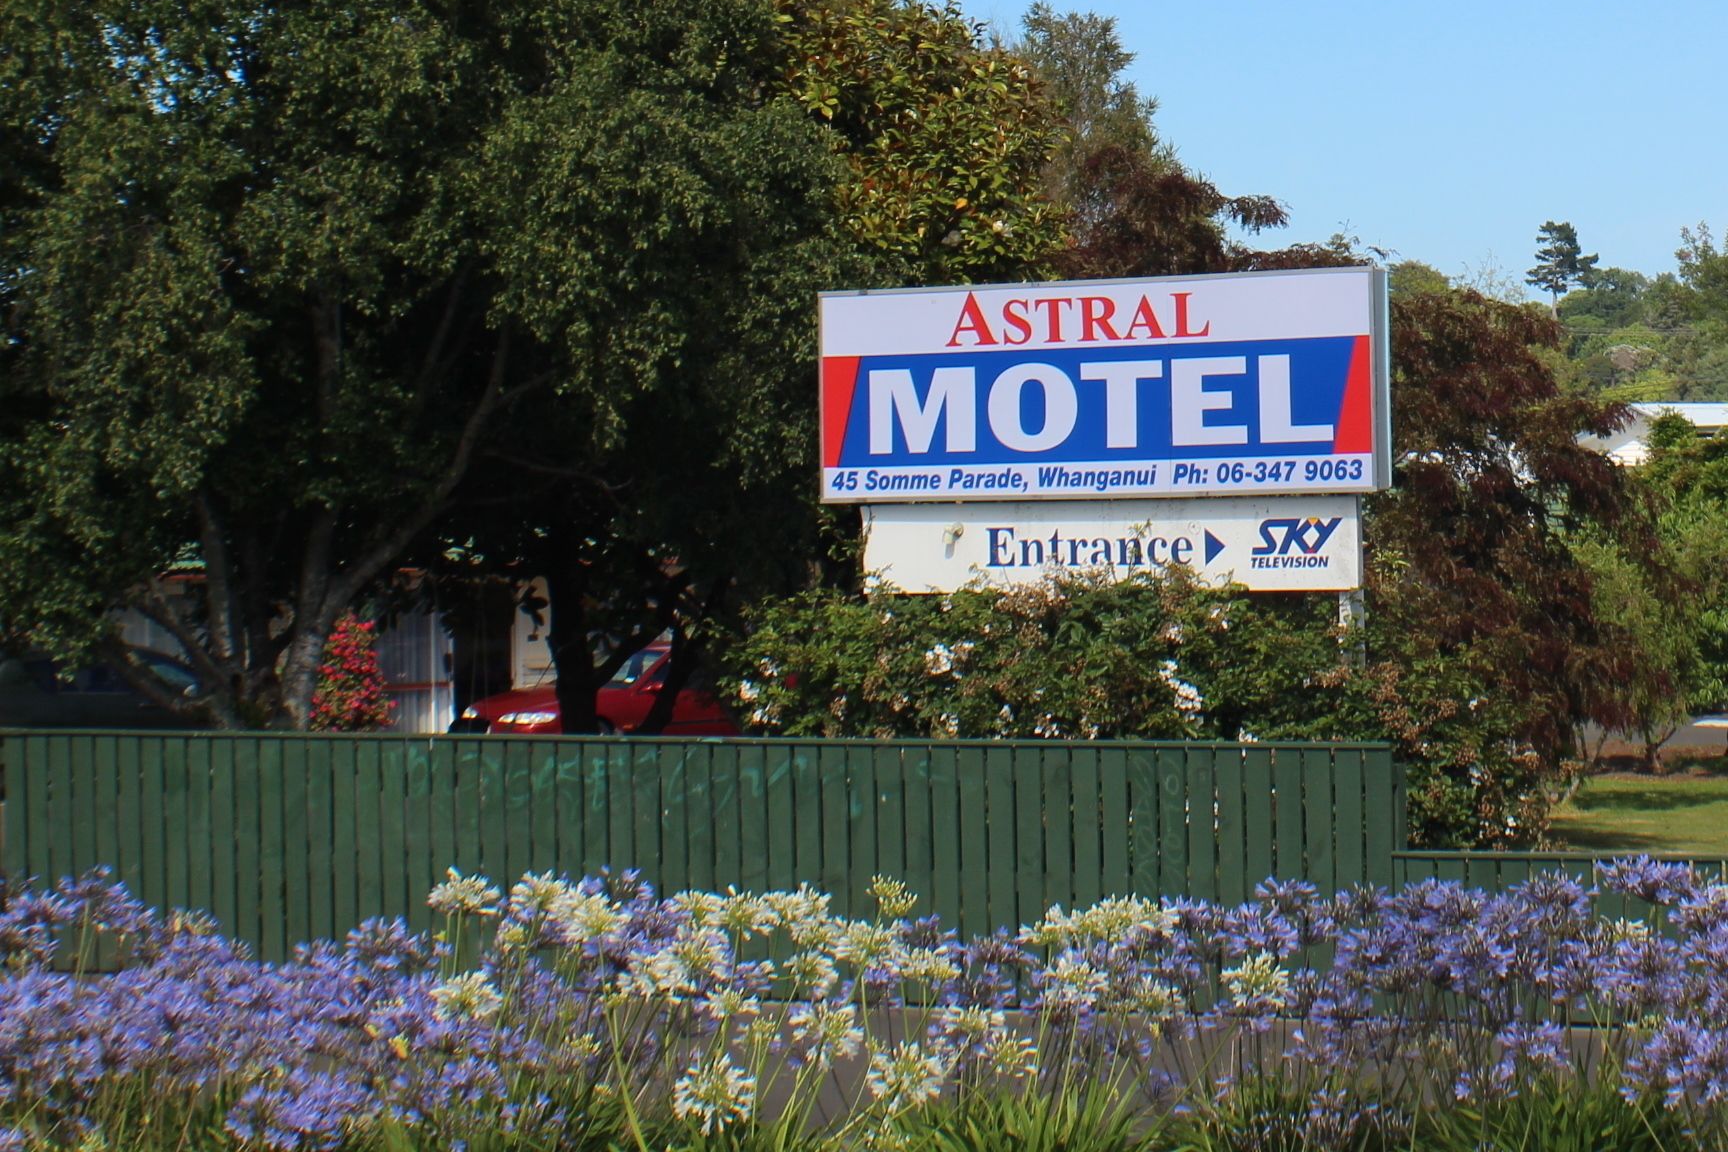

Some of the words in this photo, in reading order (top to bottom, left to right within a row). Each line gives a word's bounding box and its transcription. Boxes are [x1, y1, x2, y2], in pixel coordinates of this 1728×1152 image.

[946, 290, 1210, 347] ASTRAL
[869, 354, 1334, 454] MOTEL
[831, 471, 858, 490] 45
[864, 471, 941, 489] Somme
[948, 468, 1029, 492] Parade,
[1037, 464, 1157, 489] Whanganui
[1172, 464, 1208, 485] Ph:
[1216, 461, 1297, 484] 06-347
[1304, 459, 1363, 482] 9063
[986, 527, 1193, 567] Entrance
[1251, 517, 1342, 555] SKY
[1250, 555, 1329, 569] TELEVISION
